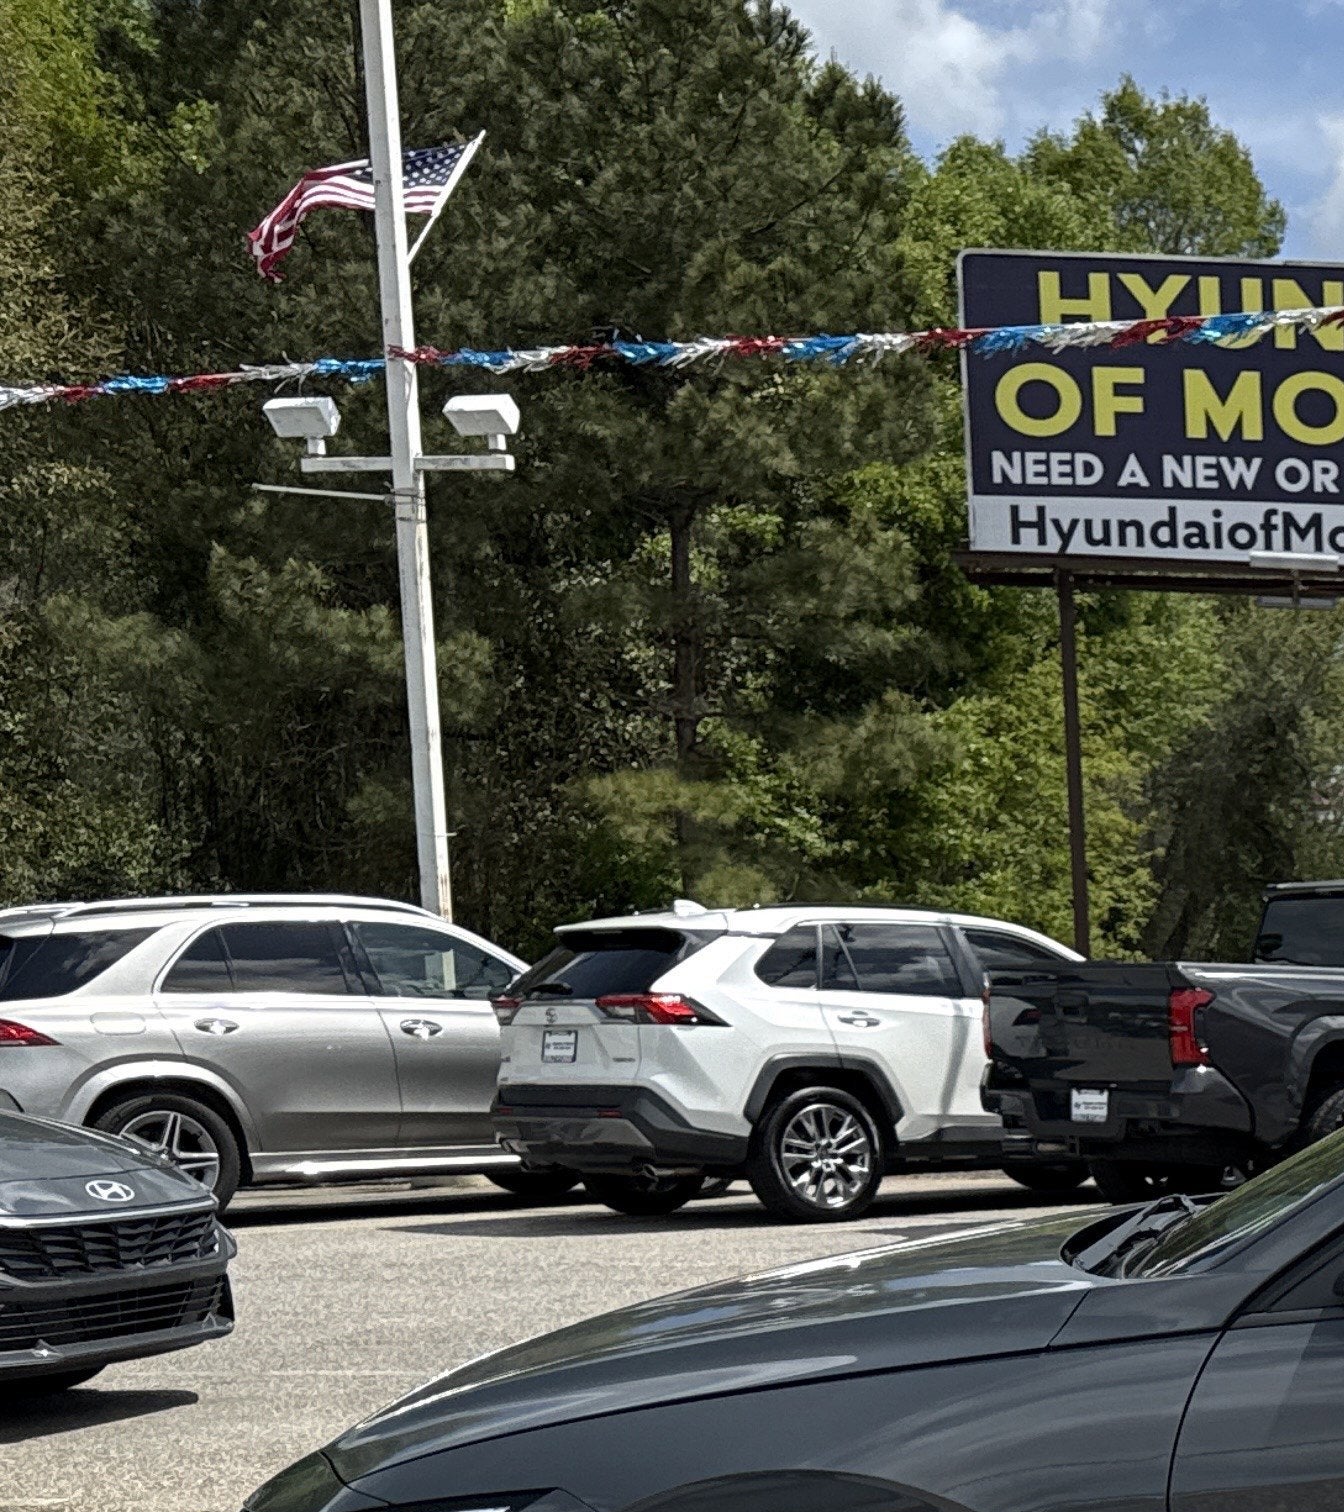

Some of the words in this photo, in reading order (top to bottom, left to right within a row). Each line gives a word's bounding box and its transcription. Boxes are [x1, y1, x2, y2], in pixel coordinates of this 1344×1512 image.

[995, 363, 1145, 437] OF
[991, 450, 1104, 486] NEED
[1117, 452, 1150, 488] A
[1162, 454, 1263, 491] NEW
[1275, 457, 1341, 494] OR
